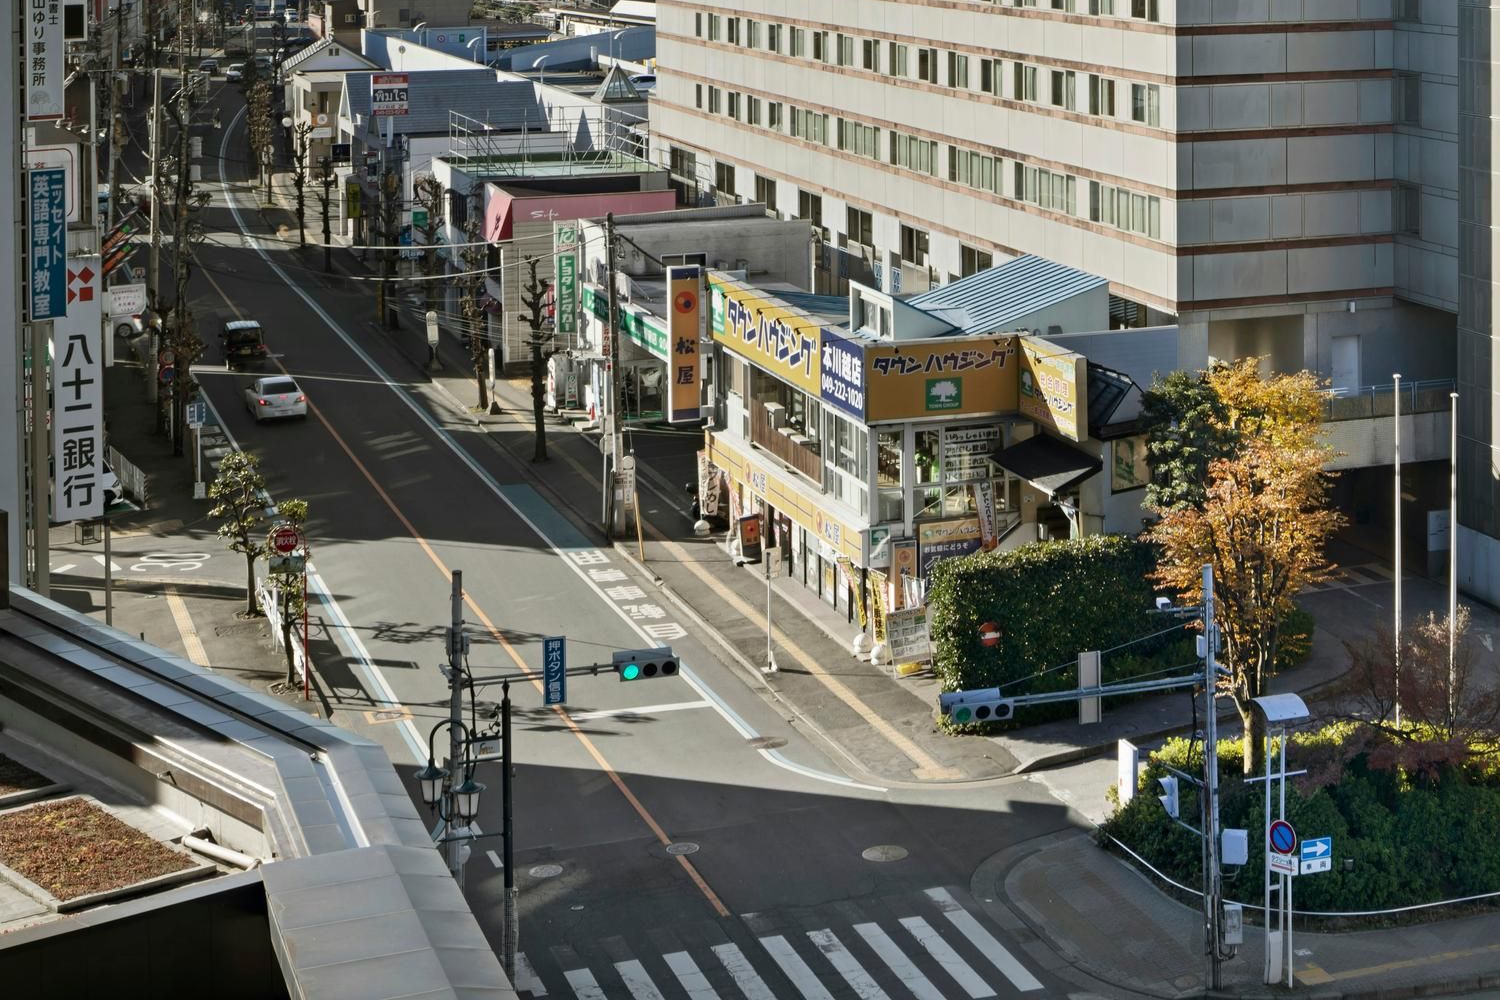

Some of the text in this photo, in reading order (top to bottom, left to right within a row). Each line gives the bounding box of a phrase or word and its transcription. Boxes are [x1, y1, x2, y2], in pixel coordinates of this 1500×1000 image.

[33, 174, 50, 316] 英語専門教室
[561, 257, 574, 332] トヨタレンタカー
[675, 337, 694, 385] 松屋
[727, 298, 817, 379] タウンハウジング
[822, 342, 862, 388] 本川越店
[873, 349, 1014, 376] タウンハウジング
[822, 374, 863, 411] 049-222-1020
[62, 334, 95, 508] 八十二銀行
[752, 471, 766, 494] 松屋
[276, 535, 296, 547] 消火栓
[824, 519, 840, 545] 松屋
[548, 641, 561, 703] 押ボタン信号
